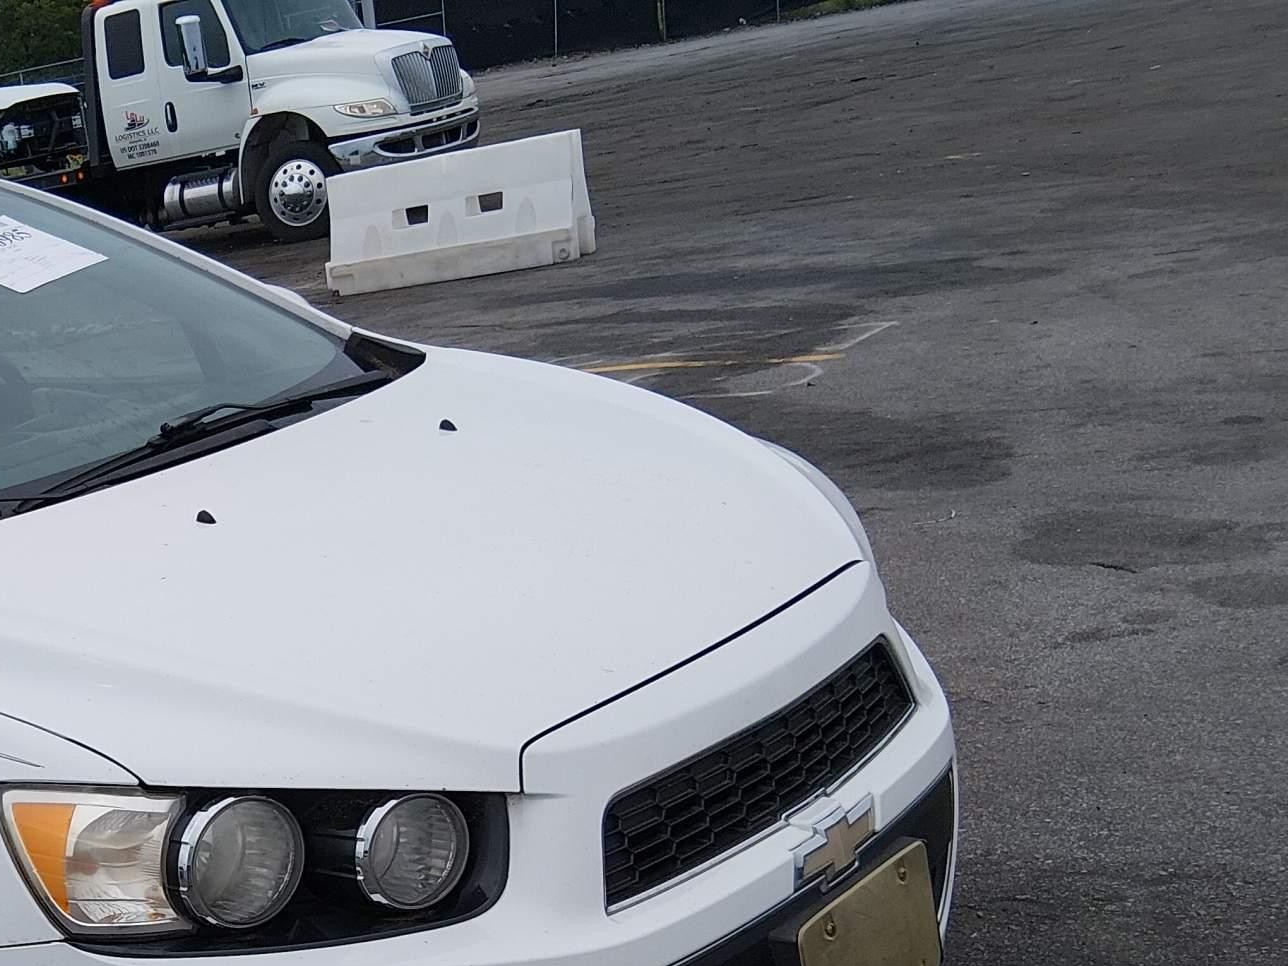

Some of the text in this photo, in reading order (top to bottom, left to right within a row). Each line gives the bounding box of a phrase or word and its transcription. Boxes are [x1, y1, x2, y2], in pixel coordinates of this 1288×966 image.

[115, 130, 146, 142] LOGISTICS
[148, 127, 160, 136] LLC
[128, 144, 138, 153] DOT
